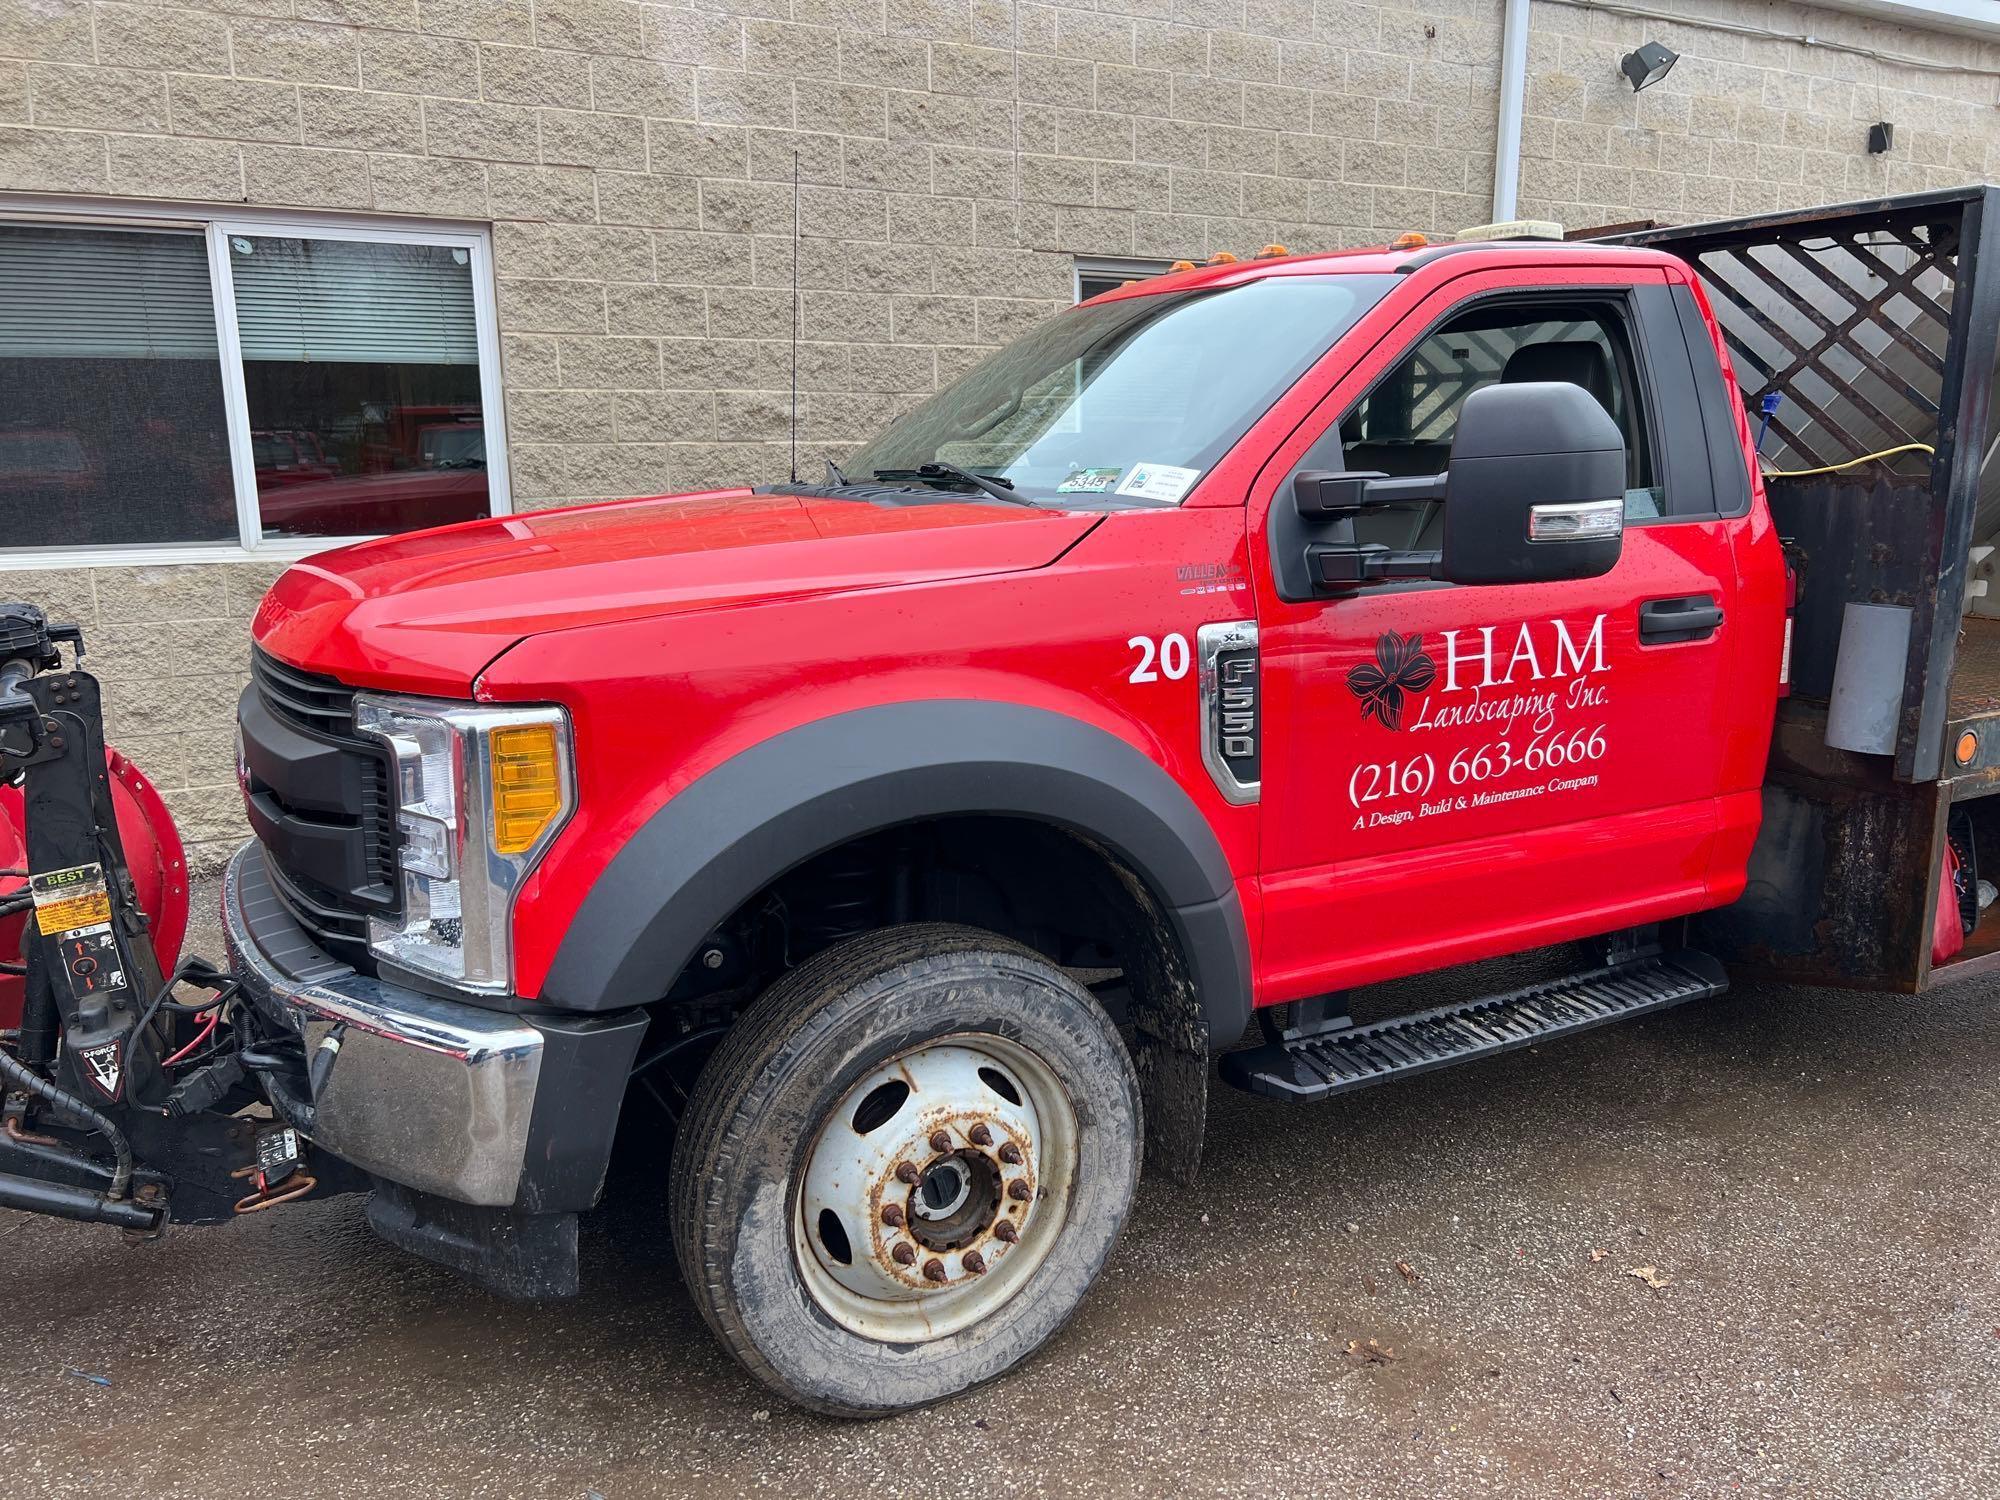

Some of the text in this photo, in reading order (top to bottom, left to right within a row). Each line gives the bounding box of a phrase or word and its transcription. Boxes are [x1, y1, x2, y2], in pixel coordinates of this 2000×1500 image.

[1127, 632, 1190, 684] 20
[1224, 633, 1245, 643] XL
[1409, 674, 1609, 736] Landscaping Inc.
[1348, 723, 1607, 809] (216) 663-6666
[1352, 774, 1600, 831] A Design, Build & Maintenance Company
[46, 869, 85, 886] BEST
[83, 1044, 117, 1059] D-FORCE
